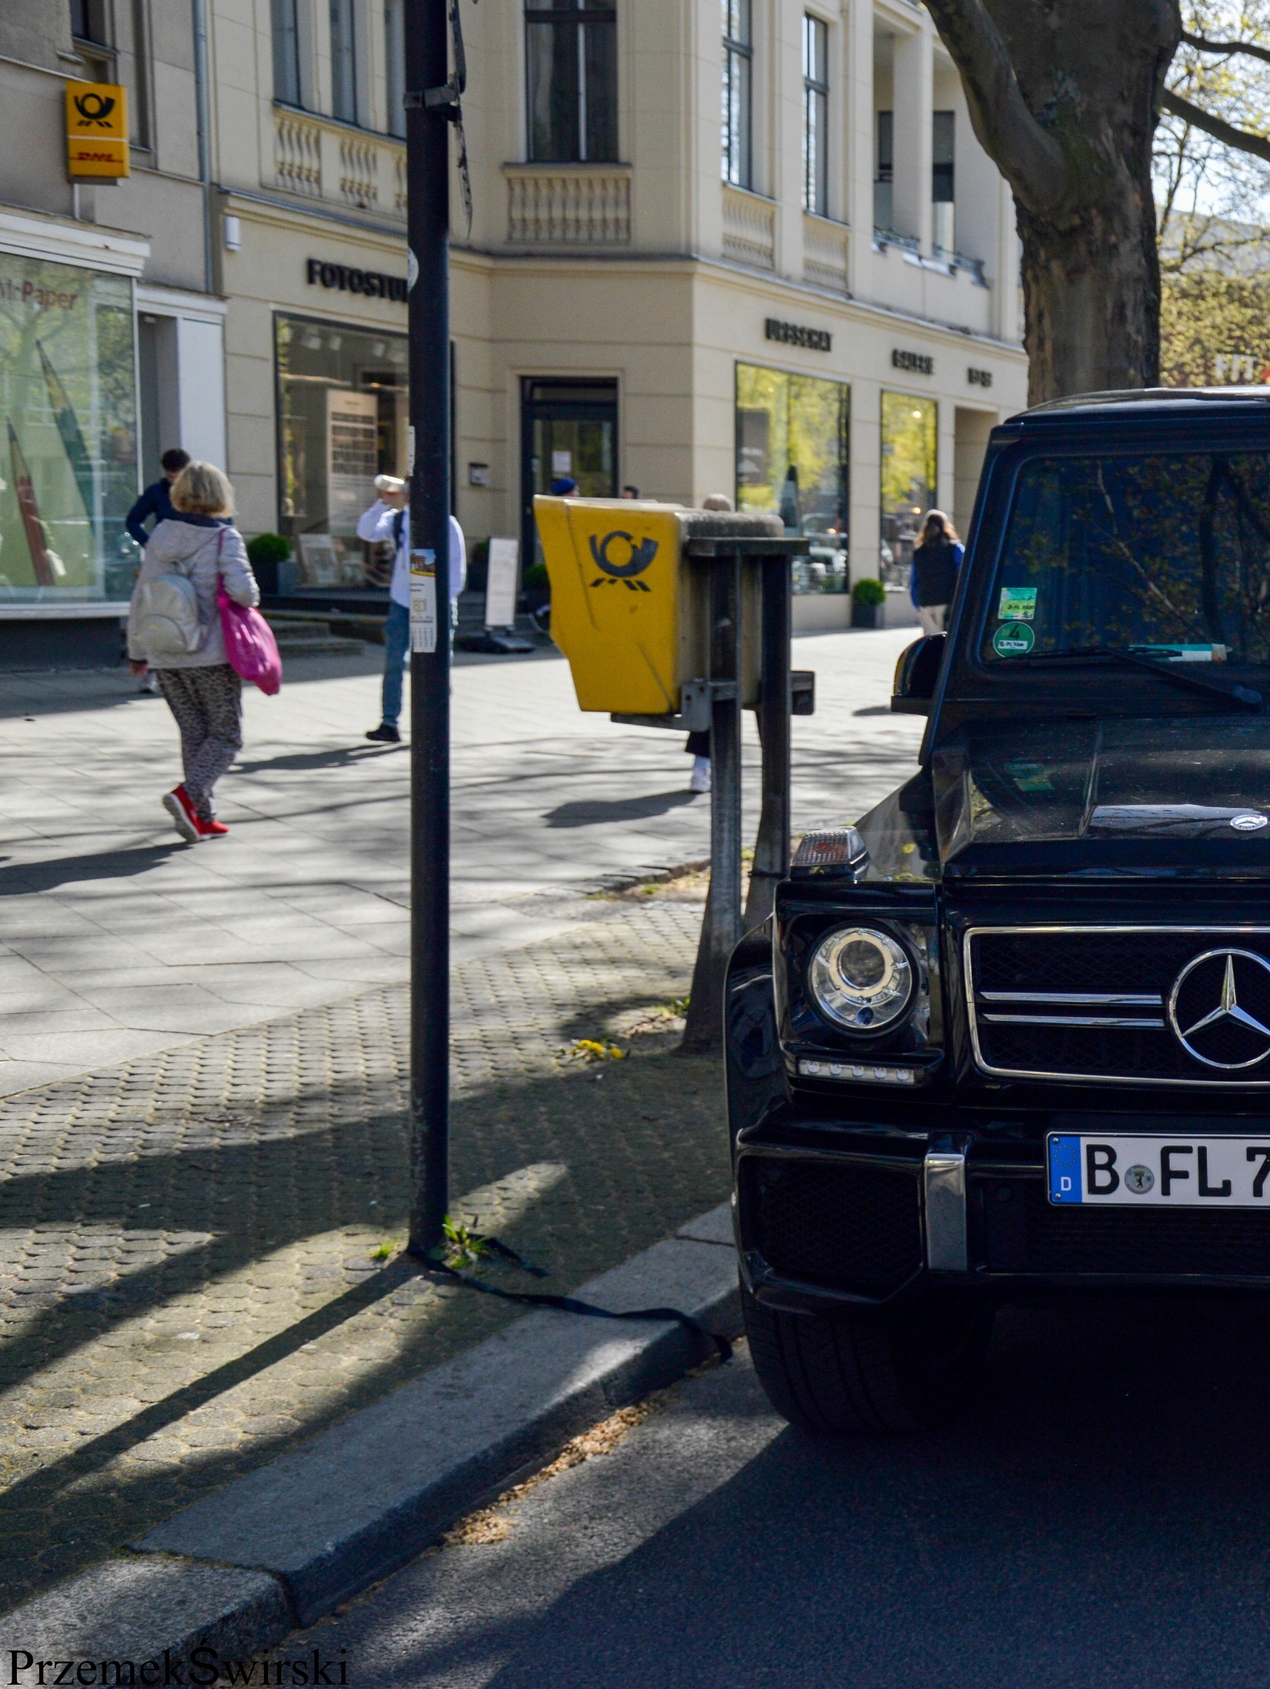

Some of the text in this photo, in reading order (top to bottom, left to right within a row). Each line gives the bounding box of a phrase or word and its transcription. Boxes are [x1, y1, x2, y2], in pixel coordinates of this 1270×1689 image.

[1060, 1176, 1072, 1192] D
[1085, 1144, 1120, 1196] B
[1160, 1145, 1232, 1197] FL
